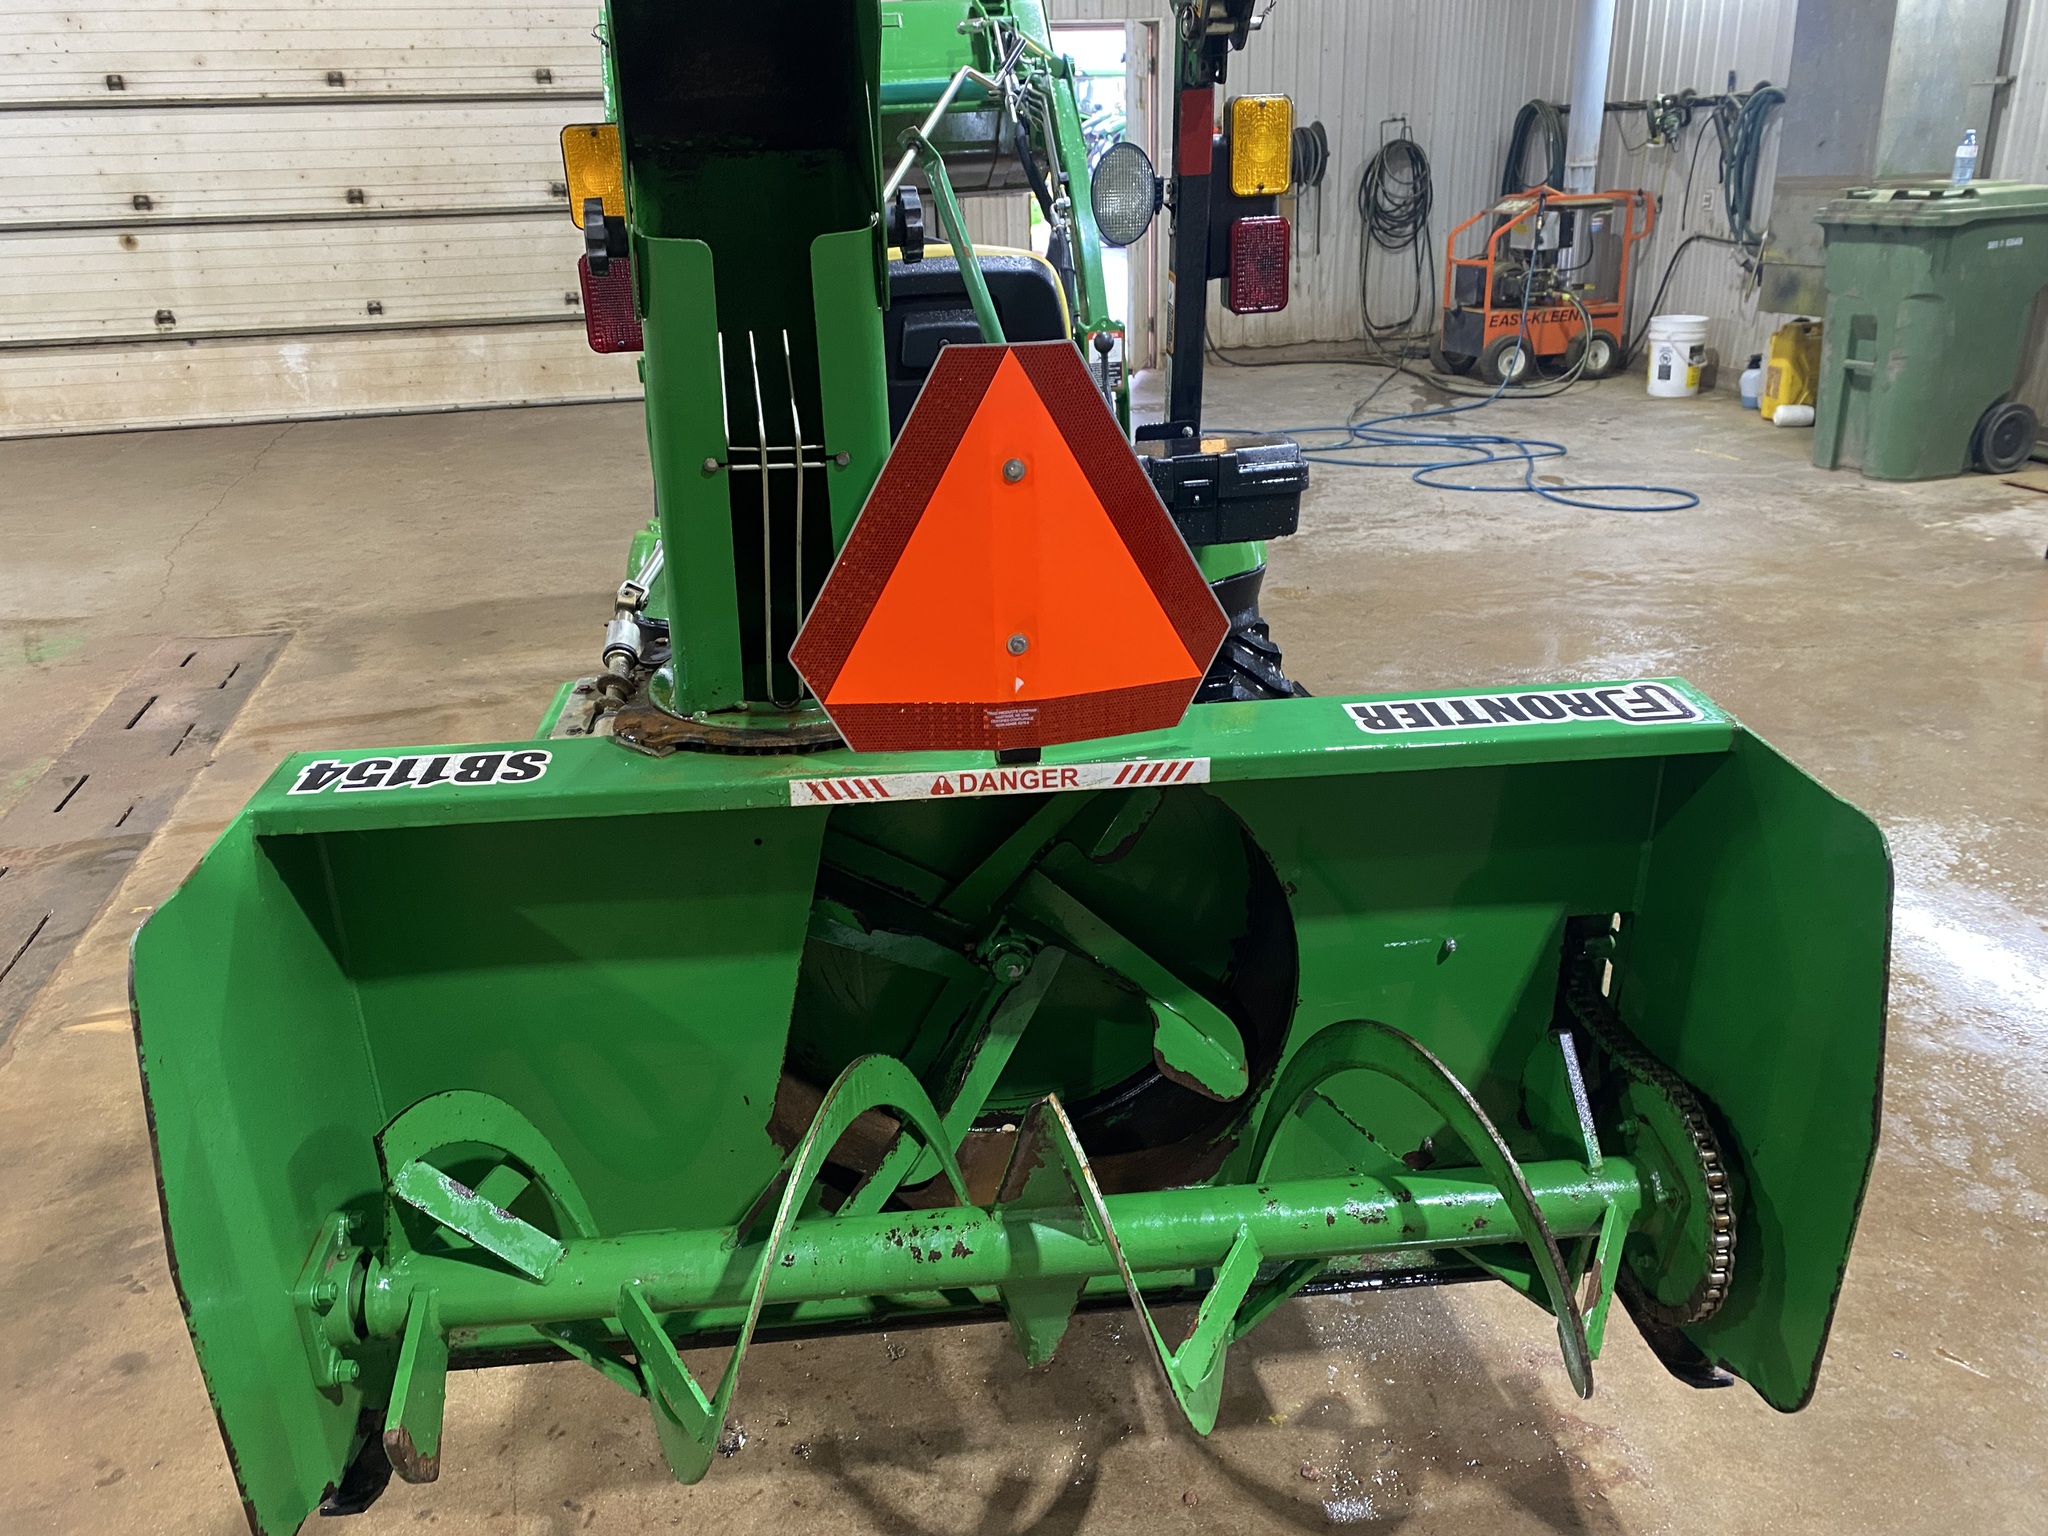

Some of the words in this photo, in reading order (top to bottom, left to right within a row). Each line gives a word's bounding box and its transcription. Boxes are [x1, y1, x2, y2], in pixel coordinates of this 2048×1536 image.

[1351, 684, 1698, 730] FRONTIER
[296, 752, 547, 791] SB1154
[959, 768, 1079, 793] DANGER
